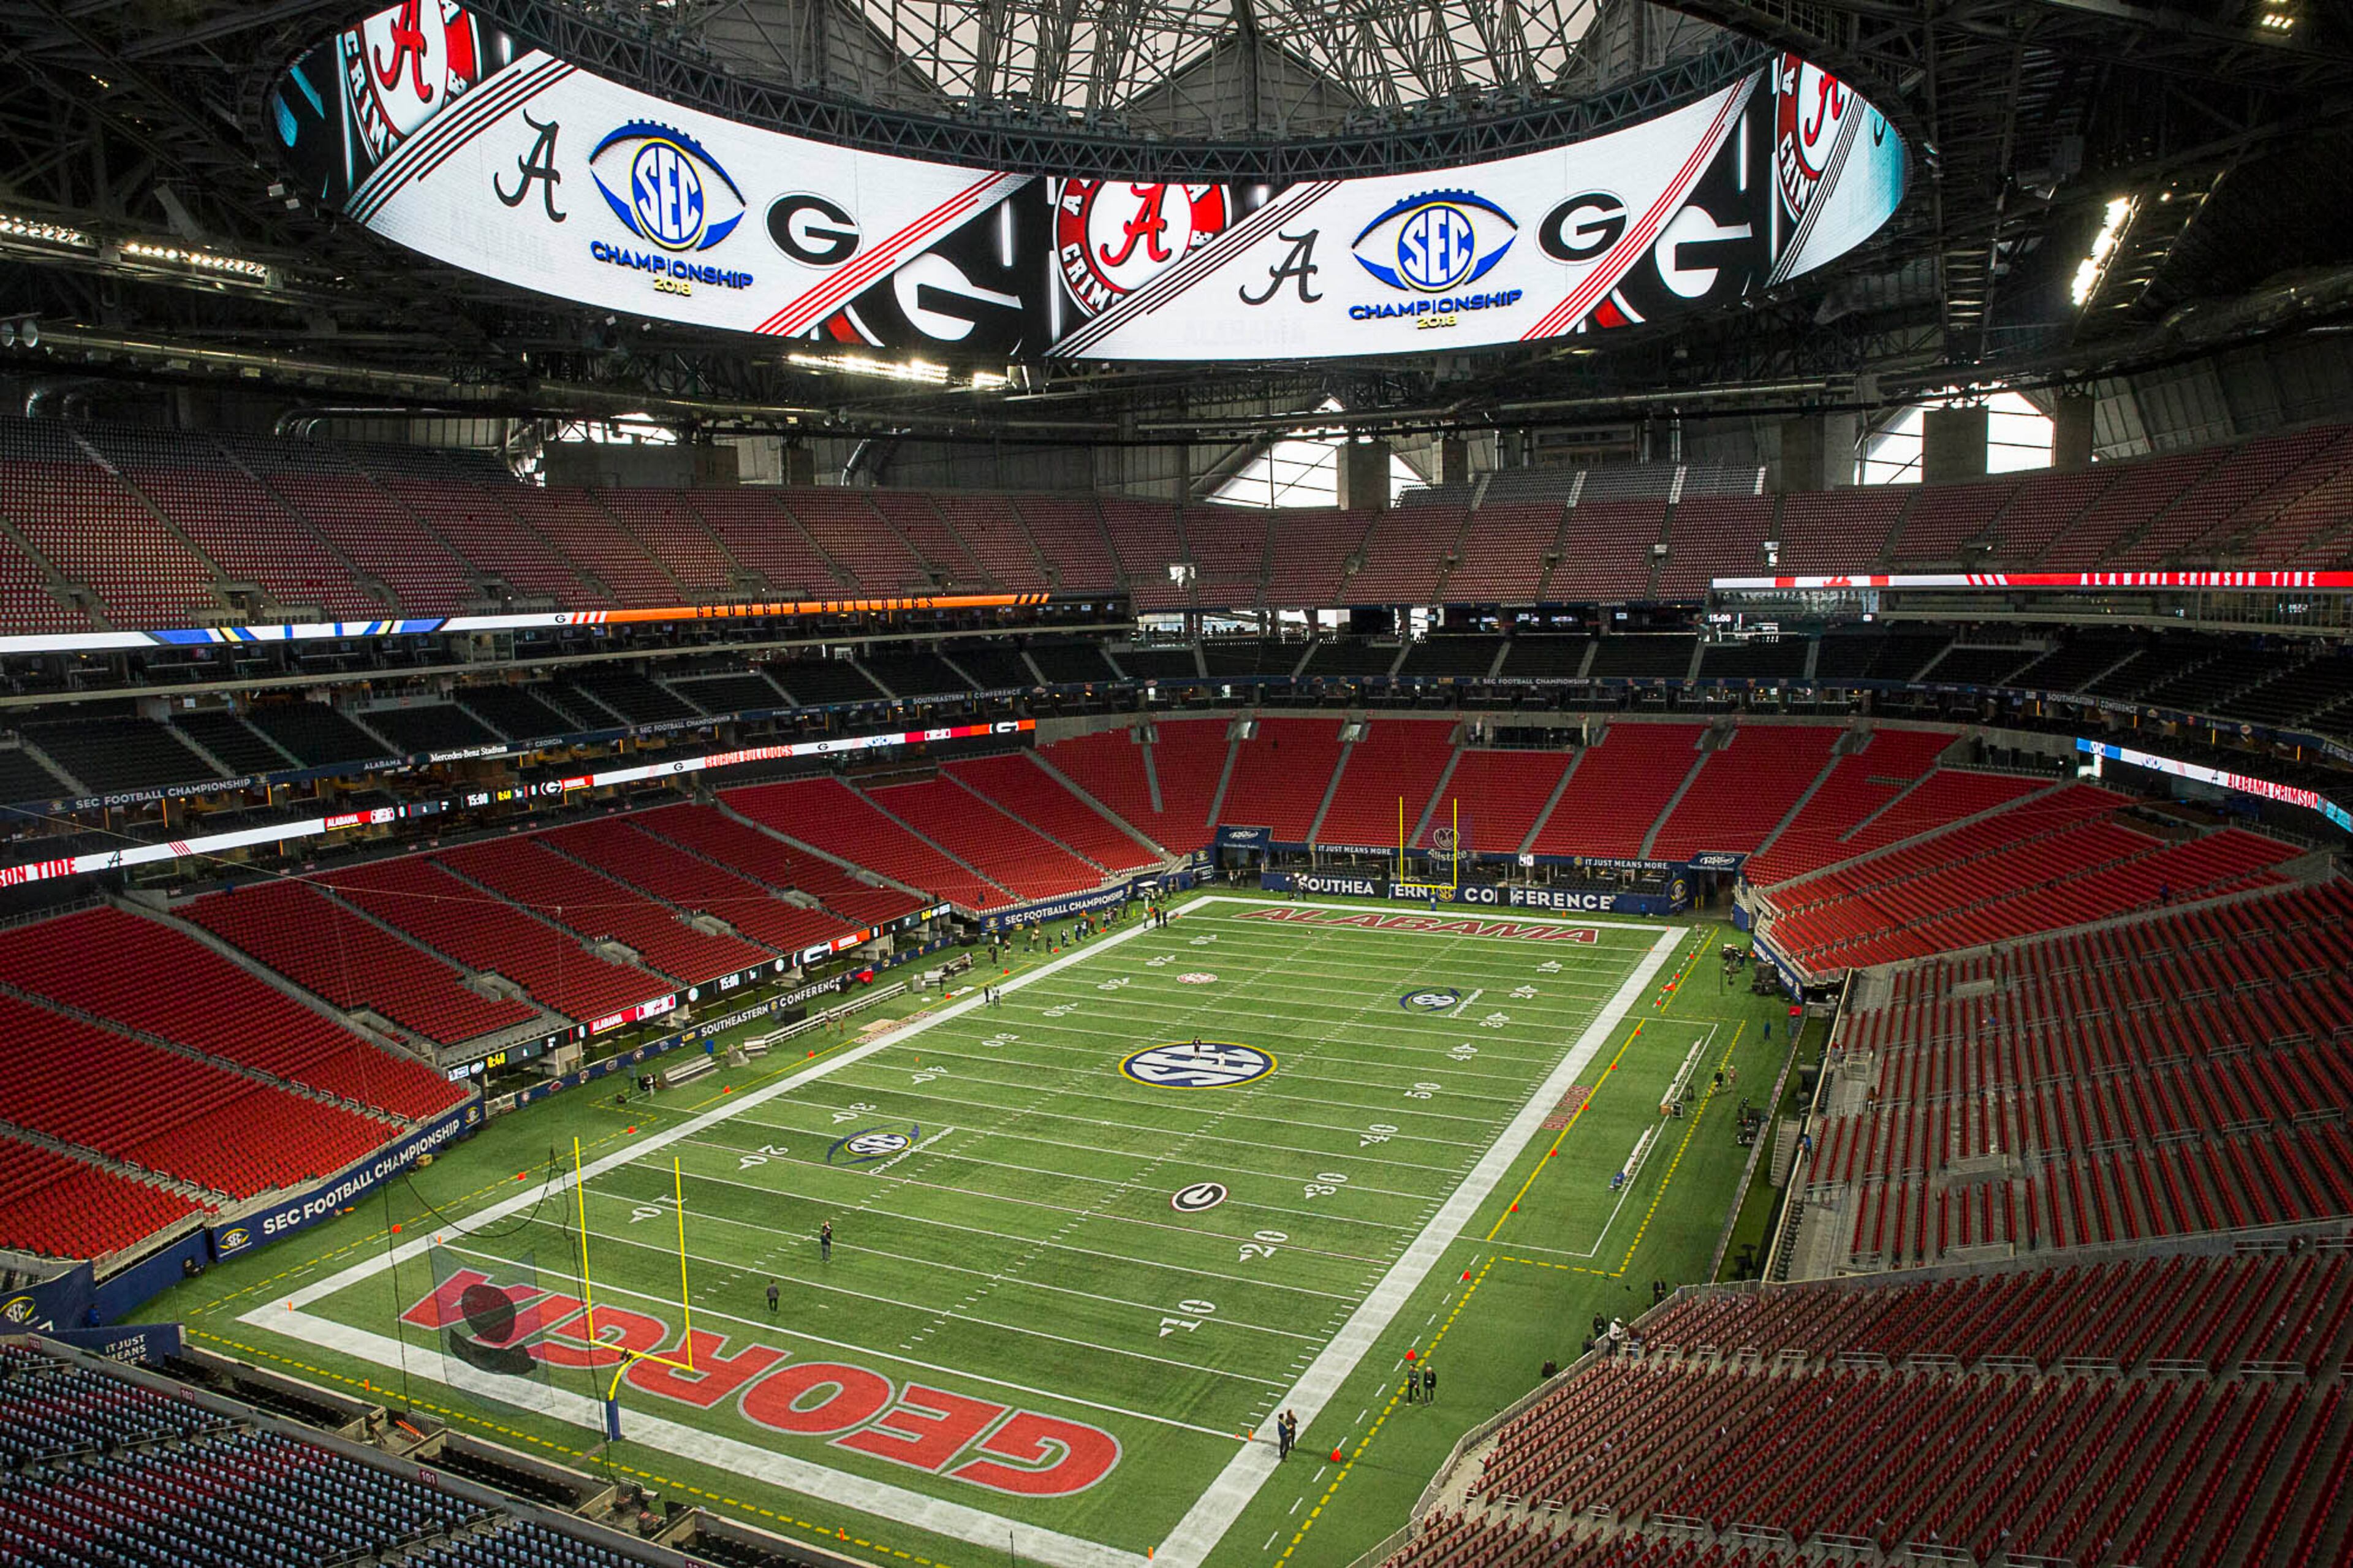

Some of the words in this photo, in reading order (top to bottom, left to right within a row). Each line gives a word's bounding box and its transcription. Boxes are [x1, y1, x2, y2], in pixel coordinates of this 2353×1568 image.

[493, 108, 567, 223] A
[634, 142, 702, 240] SEC
[766, 194, 859, 265] G
[1538, 194, 1627, 261] G
[1401, 207, 1471, 286] SEC
[590, 240, 754, 290] CHAMPIONSHIP
[1239, 229, 1323, 305] A
[653, 276, 692, 296] 2018
[1349, 289, 1523, 320] CHAMPIONSHIP
[1417, 314, 1457, 329] 2018
[2080, 572, 2167, 586] ALABAMA
[2178, 572, 2256, 586] CRIMSON
[2270, 571, 2316, 586] TIDE
[912, 693, 965, 705] SOUTHEASTERN
[974, 688, 1021, 699] CONFERENCE
[639, 725, 652, 734] SEC
[653, 721, 685, 732] FOOTBALL
[534, 737, 563, 748] GEORGIA
[430, 748, 480, 762] Mercedes-Benz
[480, 745, 508, 756] Stadium
[363, 759, 402, 770] ALABAMA
[673, 762, 684, 771] G
[75, 798, 100, 809] SEC
[104, 790, 164, 806] FOOTBALL
[167, 778, 251, 797] CHAMPIONSHIP
[467, 792, 489, 806] 15:00
[2227, 773, 2270, 798] ALABAMA
[2272, 783, 2318, 809] CRIMSON
[327, 814, 359, 828] ALABAMA
[1427, 847, 1468, 862] Allstte
[1585, 858, 1591, 866] IT
[1593, 858, 1612, 868] JUST
[1614, 860, 1642, 869] MEANS
[34, 857, 77, 879] TIDE
[1004, 912, 1023, 926] SEC
[1023, 903, 1069, 921] FOOTBALL
[1069, 889, 1124, 912] CHAMPIONSHIP
[1232, 907, 1599, 944] ALABAMA
[719, 974, 740, 991] 15:00
[592, 1013, 623, 1031] ALABAMA
[700, 1003, 769, 1037] SOUTHEASTERN
[1480, 1013, 1510, 1028] 30
[1447, 1044, 1478, 1061] 40
[1131, 1044, 1265, 1086] SEC
[1404, 1082, 1441, 1099] 50
[848, 1133, 910, 1155] SEC
[1362, 1124, 1398, 1143] 40
[868, 1126, 956, 1175] CHAMPIONSHIP
[263, 1208, 300, 1235] SEC
[303, 1171, 374, 1220] FOOTBALL
[374, 1118, 460, 1180] CHAMPIONSHIP
[1303, 1173, 1348, 1196] 30
[1175, 1183, 1224, 1210] G
[226, 1232, 243, 1247] SEC
[1238, 1230, 1289, 1259] 20
[6, 1303, 25, 1323] SEC
[1160, 1299, 1217, 1333] 10
[105, 1343, 115, 1354] IT
[117, 1334, 146, 1350] JUST
[398, 1267, 1123, 1498] GEORGIA
[421, 1471, 435, 1485] 101
